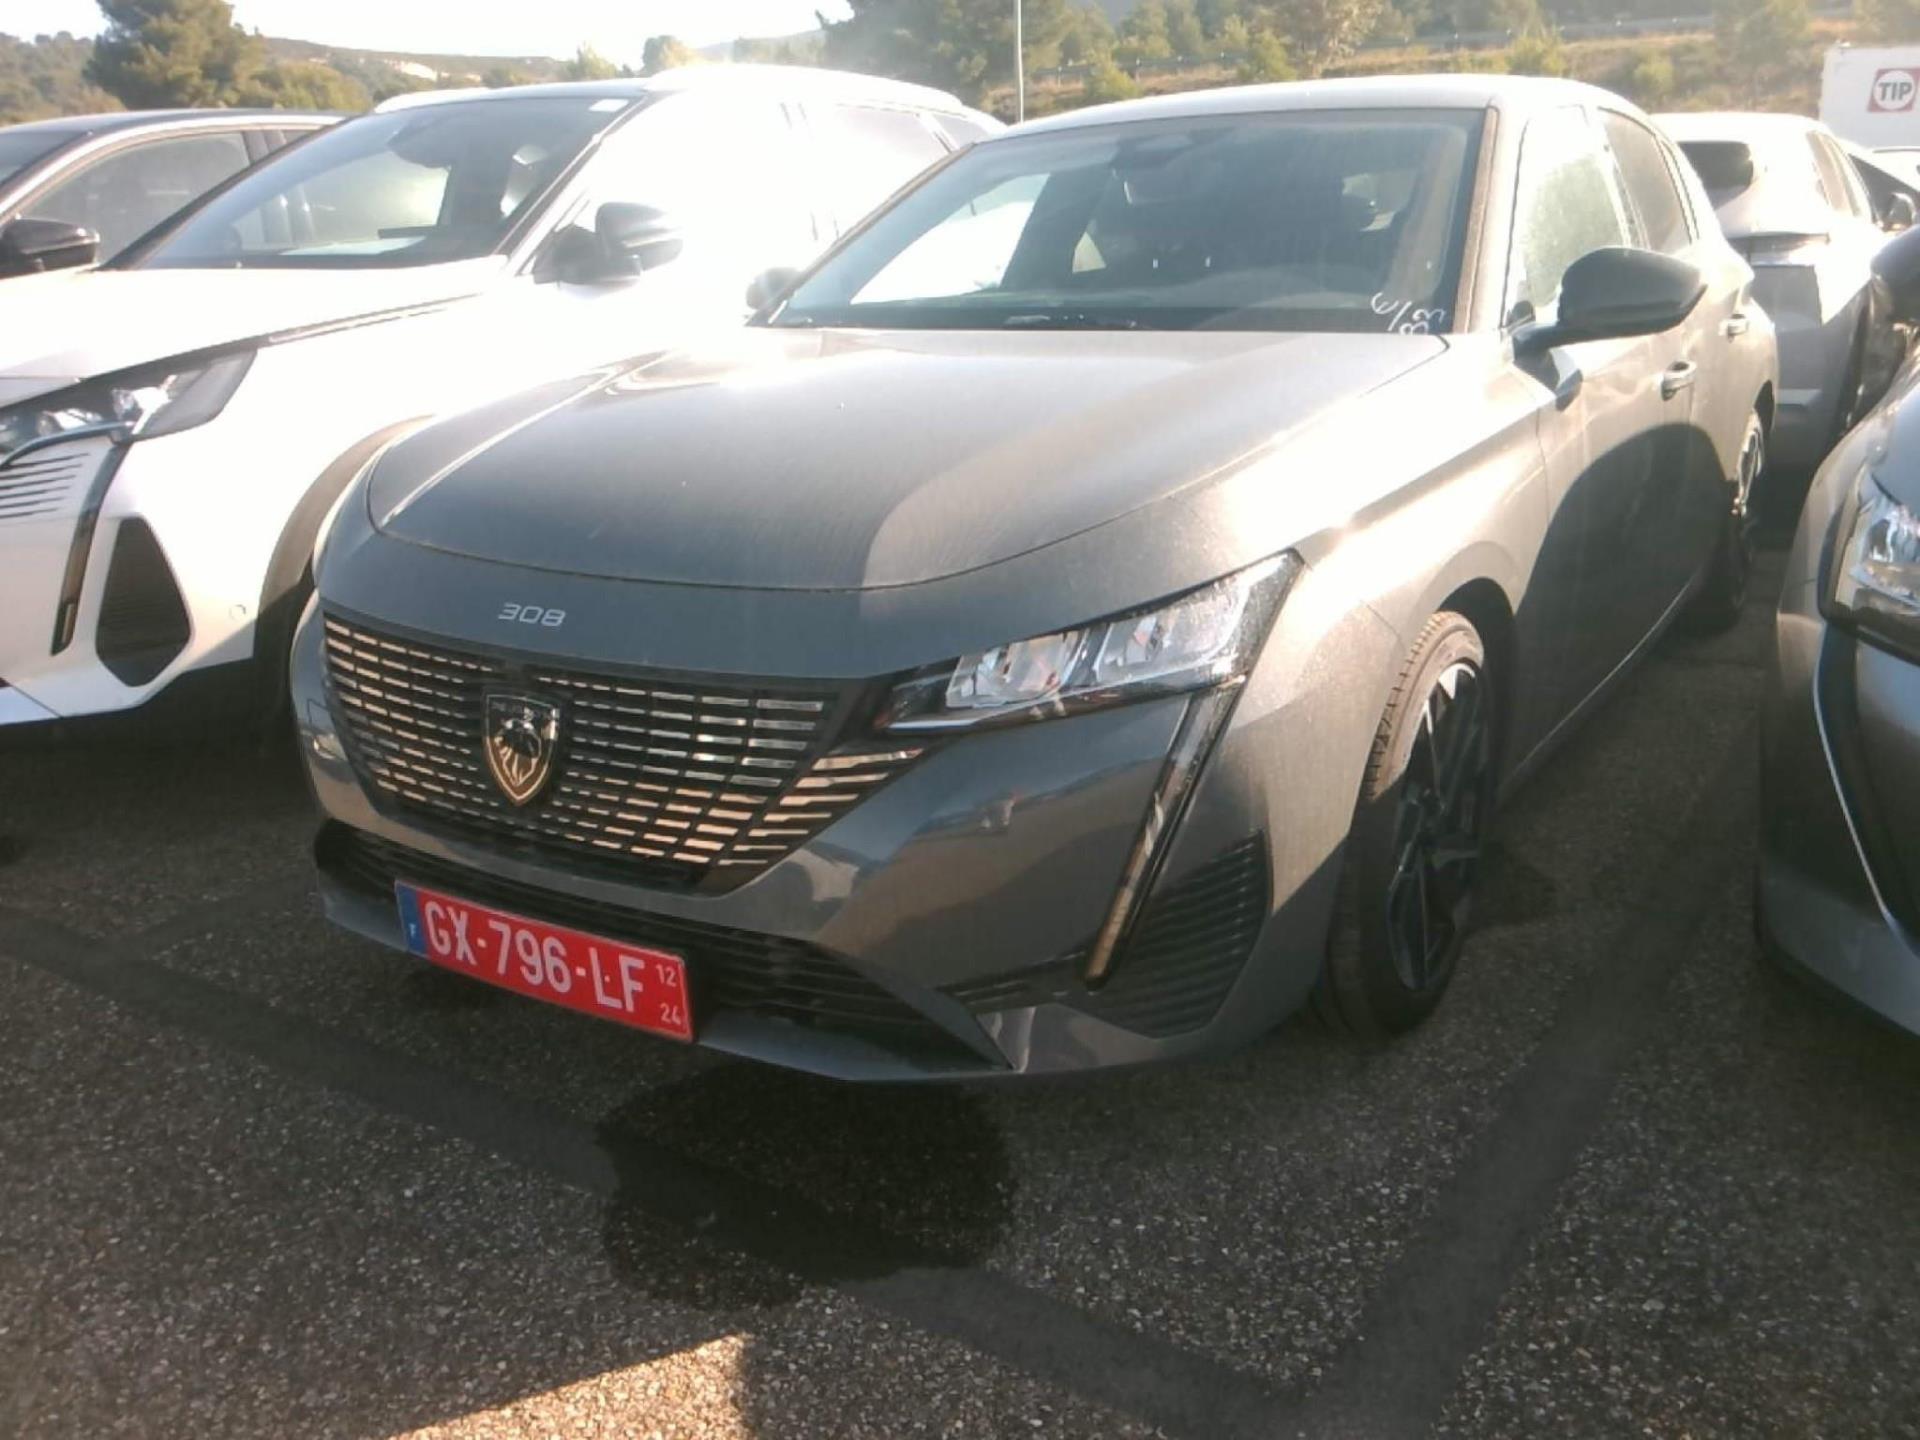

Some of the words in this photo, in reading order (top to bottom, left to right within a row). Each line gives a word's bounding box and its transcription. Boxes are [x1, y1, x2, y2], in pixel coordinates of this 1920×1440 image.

[1878, 81, 1913, 102] TIP
[498, 602, 566, 627] 308
[425, 900, 645, 1013] GX-796-LF
[656, 964, 677, 988] 12
[660, 1001, 682, 1025] 24
